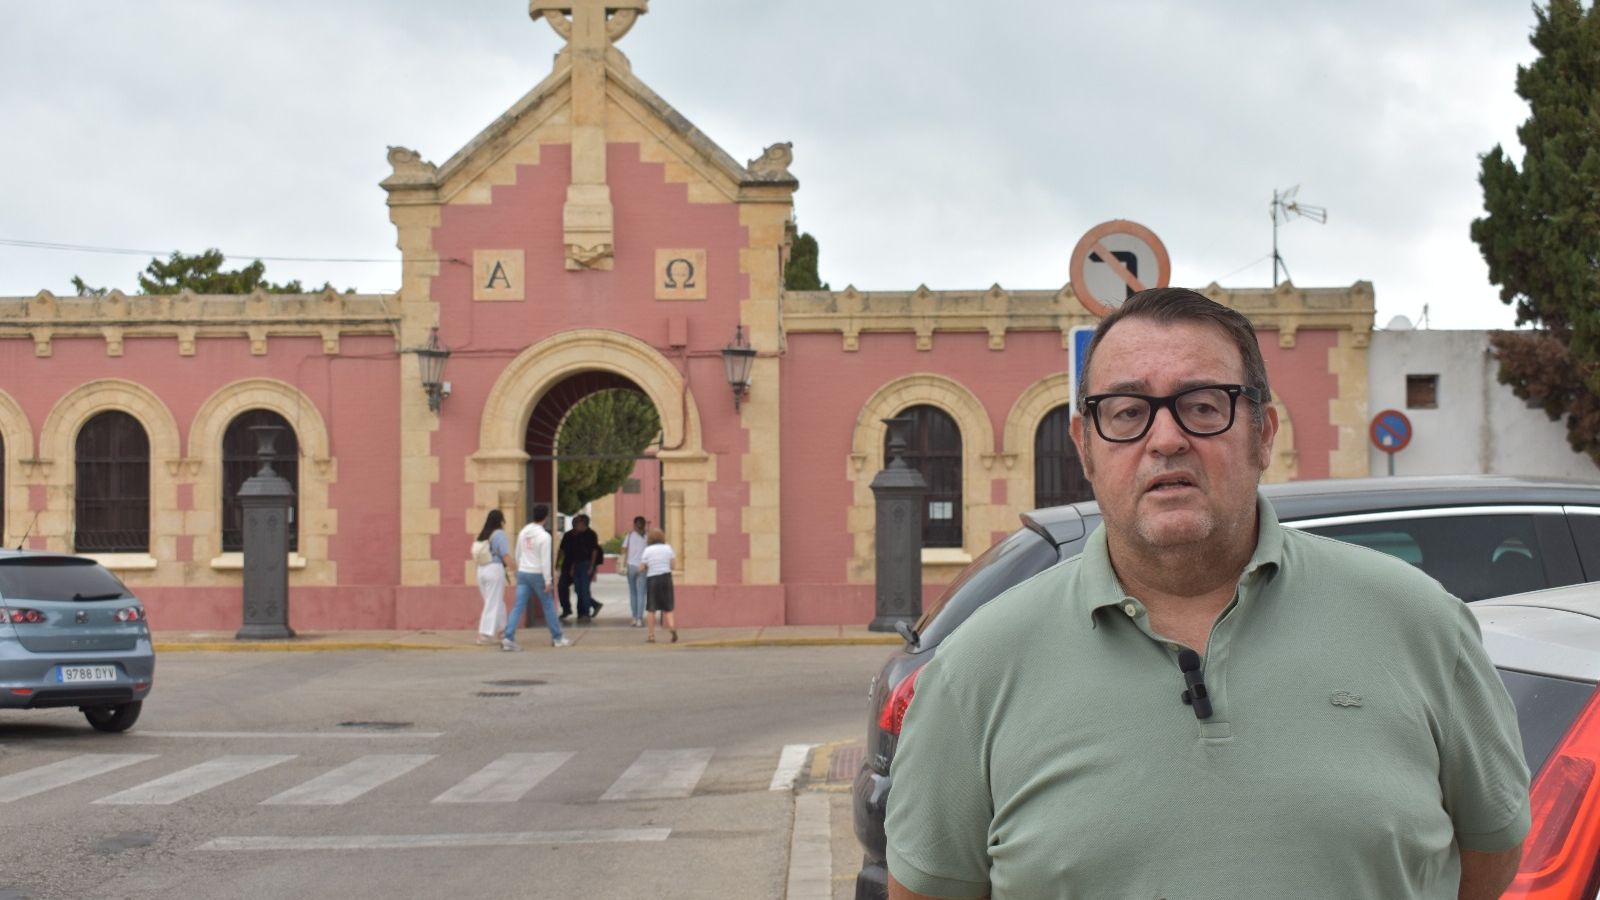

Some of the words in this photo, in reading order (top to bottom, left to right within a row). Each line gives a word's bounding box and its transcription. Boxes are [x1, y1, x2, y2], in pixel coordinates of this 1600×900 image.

[664, 258, 696, 289] Ω
[65, 668, 93, 680] 9788
[95, 667, 114, 679] DYV
